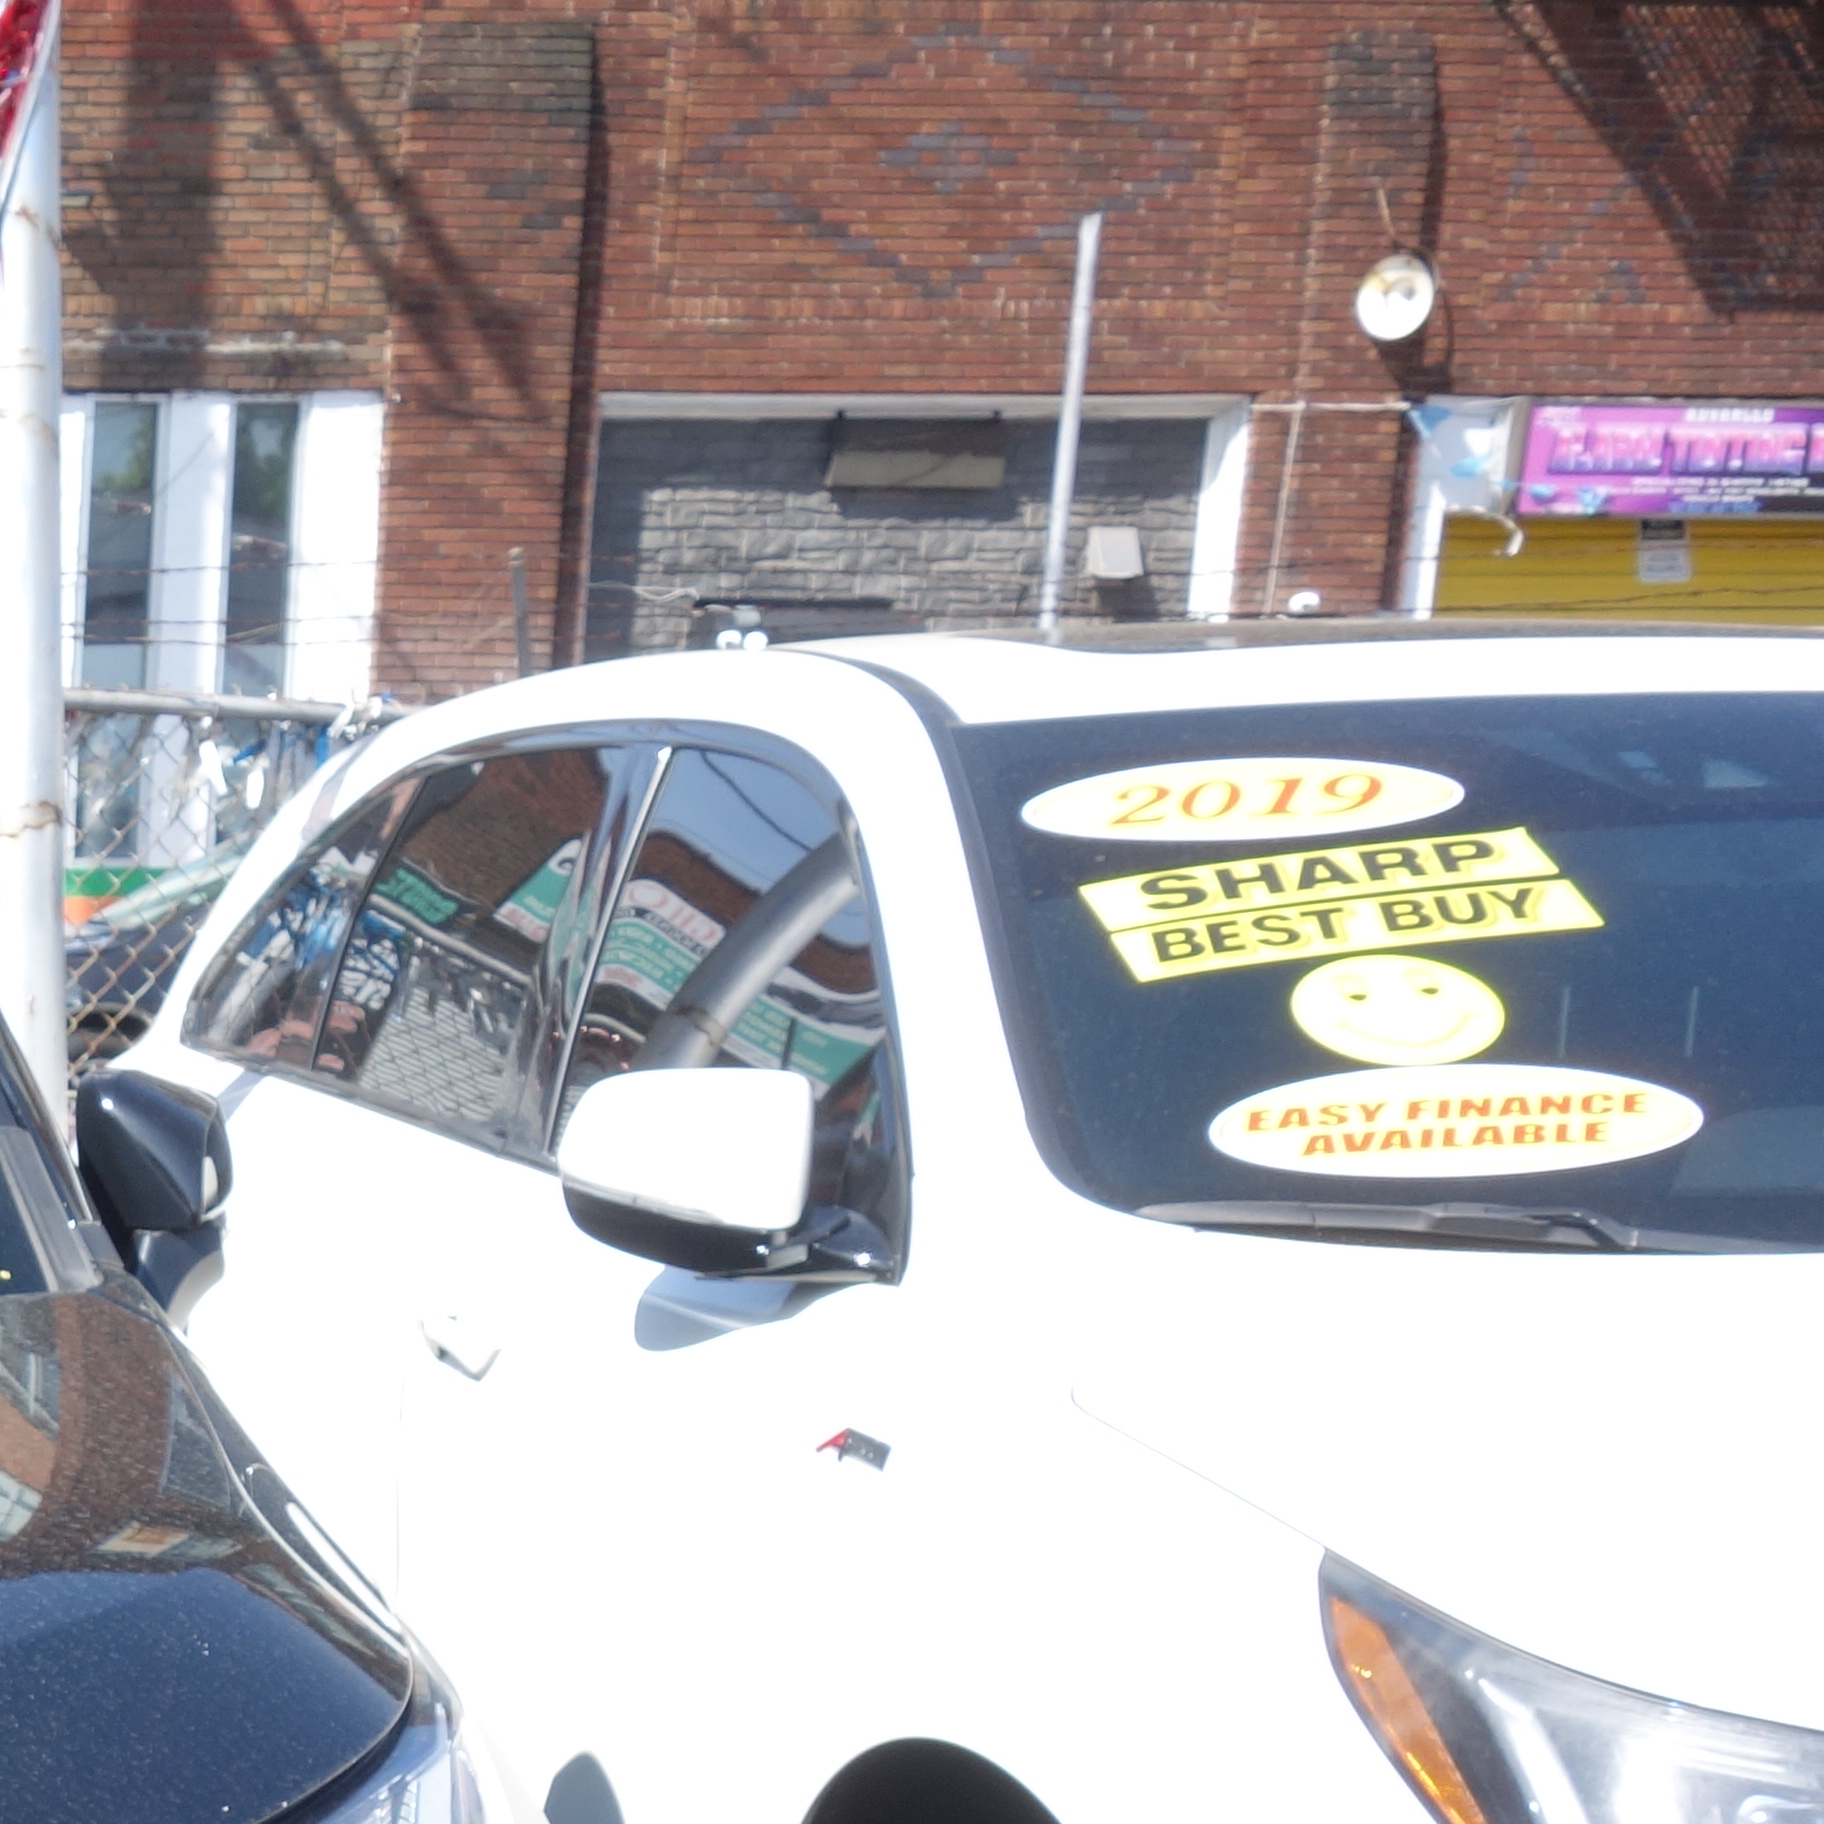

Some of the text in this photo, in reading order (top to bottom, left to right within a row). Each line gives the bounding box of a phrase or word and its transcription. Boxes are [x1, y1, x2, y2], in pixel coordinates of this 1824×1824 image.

[1109, 774, 1383, 827] 2019
[1140, 839, 1496, 911] SHARP
[1152, 887, 1538, 963] BEST BUY
[1247, 1093, 1649, 1133] EASY FINANCE
[1302, 1122, 1610, 1157] AVAILABLE
